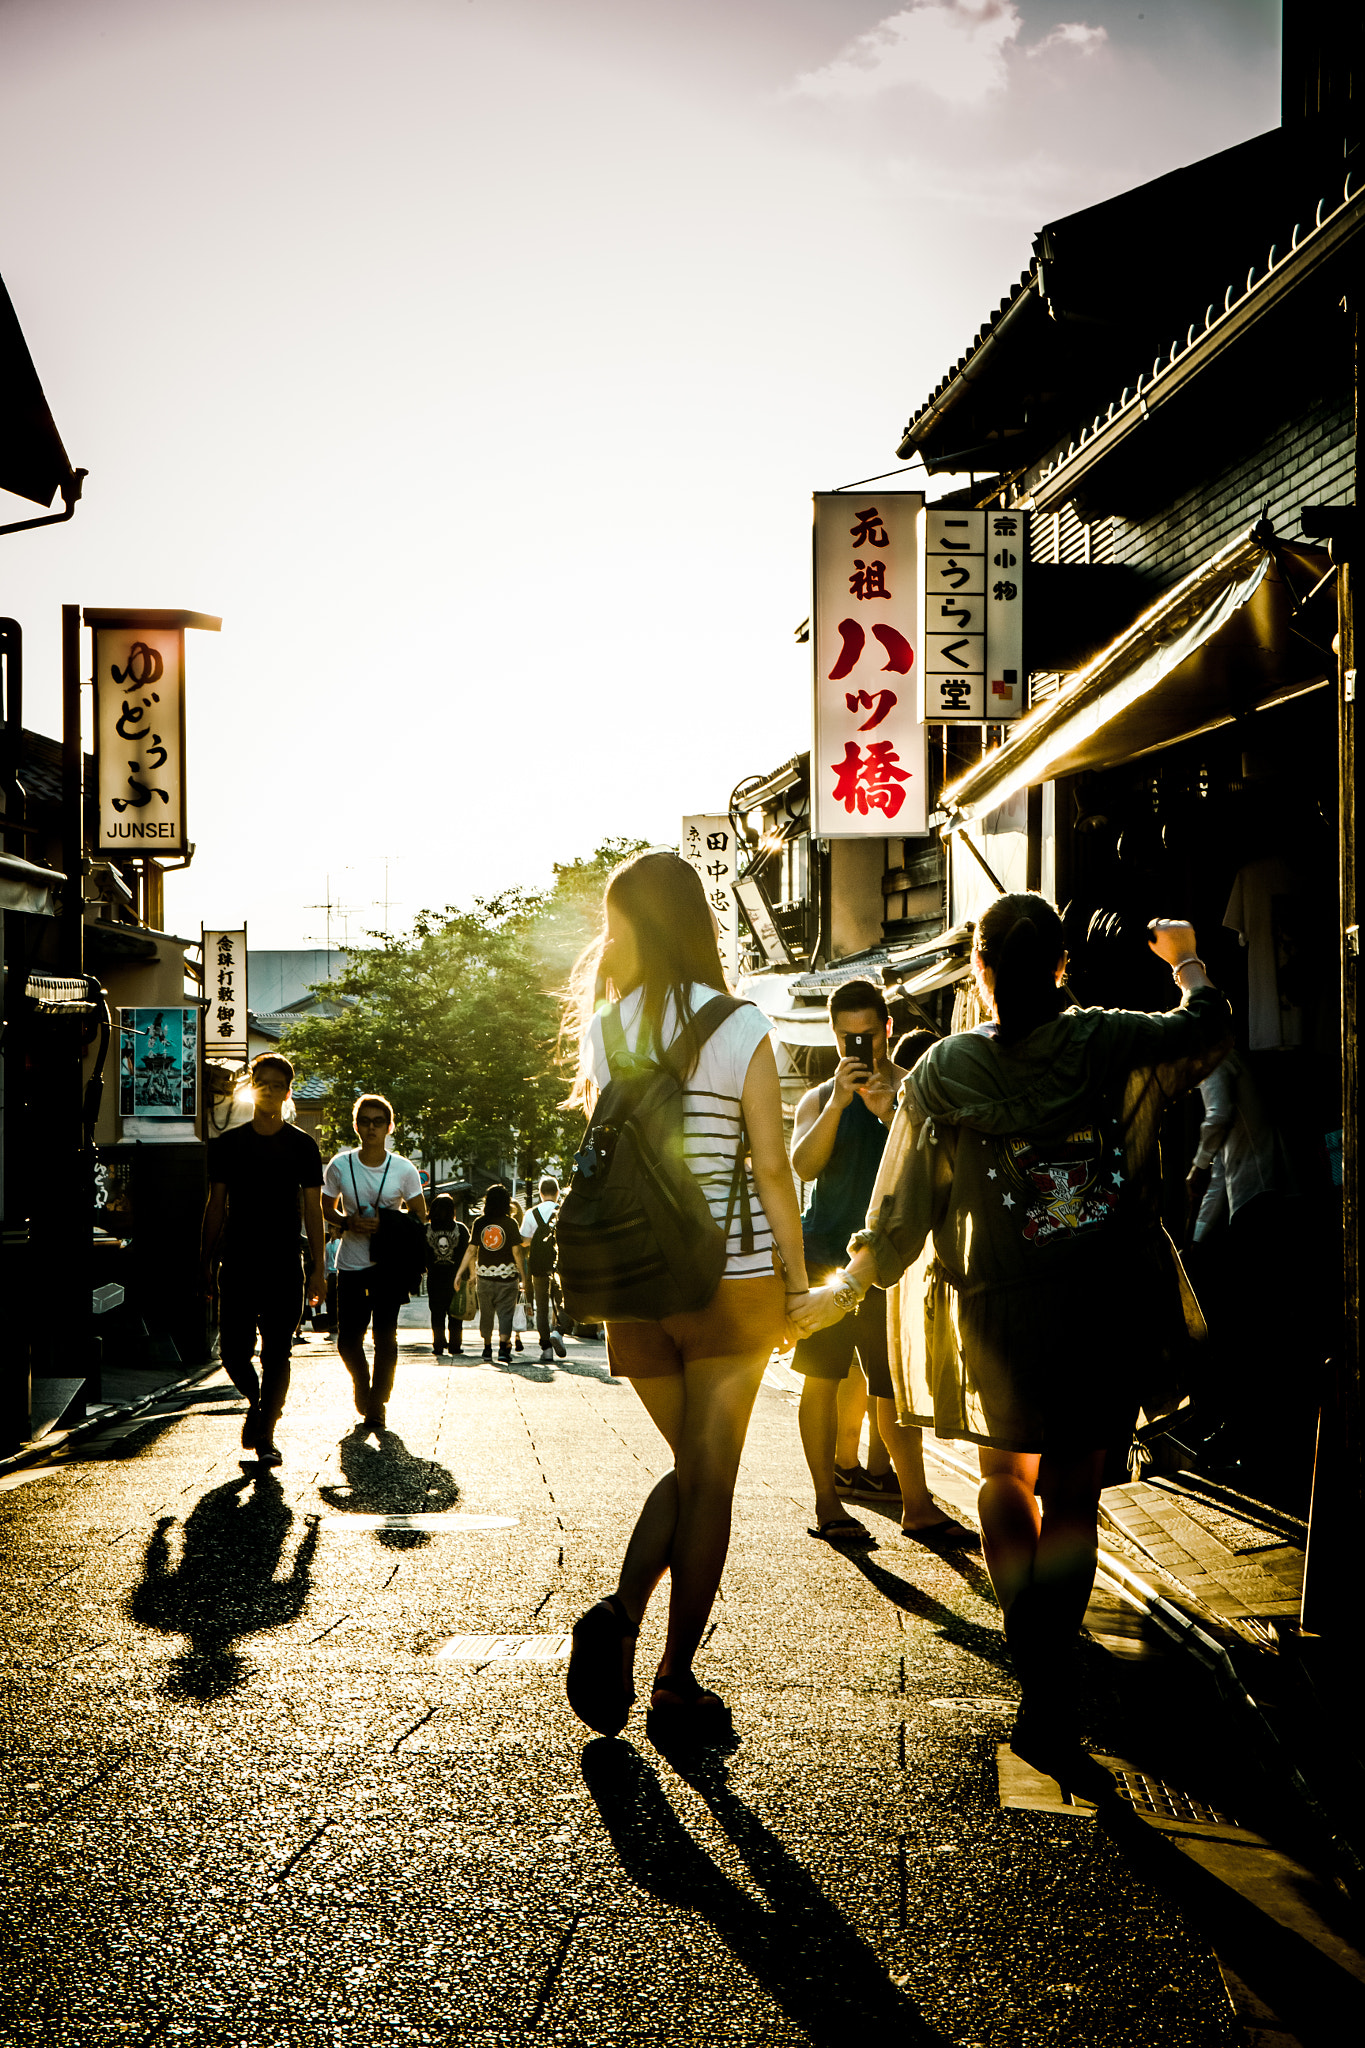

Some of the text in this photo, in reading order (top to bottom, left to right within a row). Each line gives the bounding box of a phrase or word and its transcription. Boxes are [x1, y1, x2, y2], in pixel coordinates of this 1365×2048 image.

[939, 519, 972, 711] こうらく堂
[992, 515, 1018, 602] 京小物
[110, 641, 170, 813] ゆどうふ
[106, 822, 175, 839] JUNSEI
